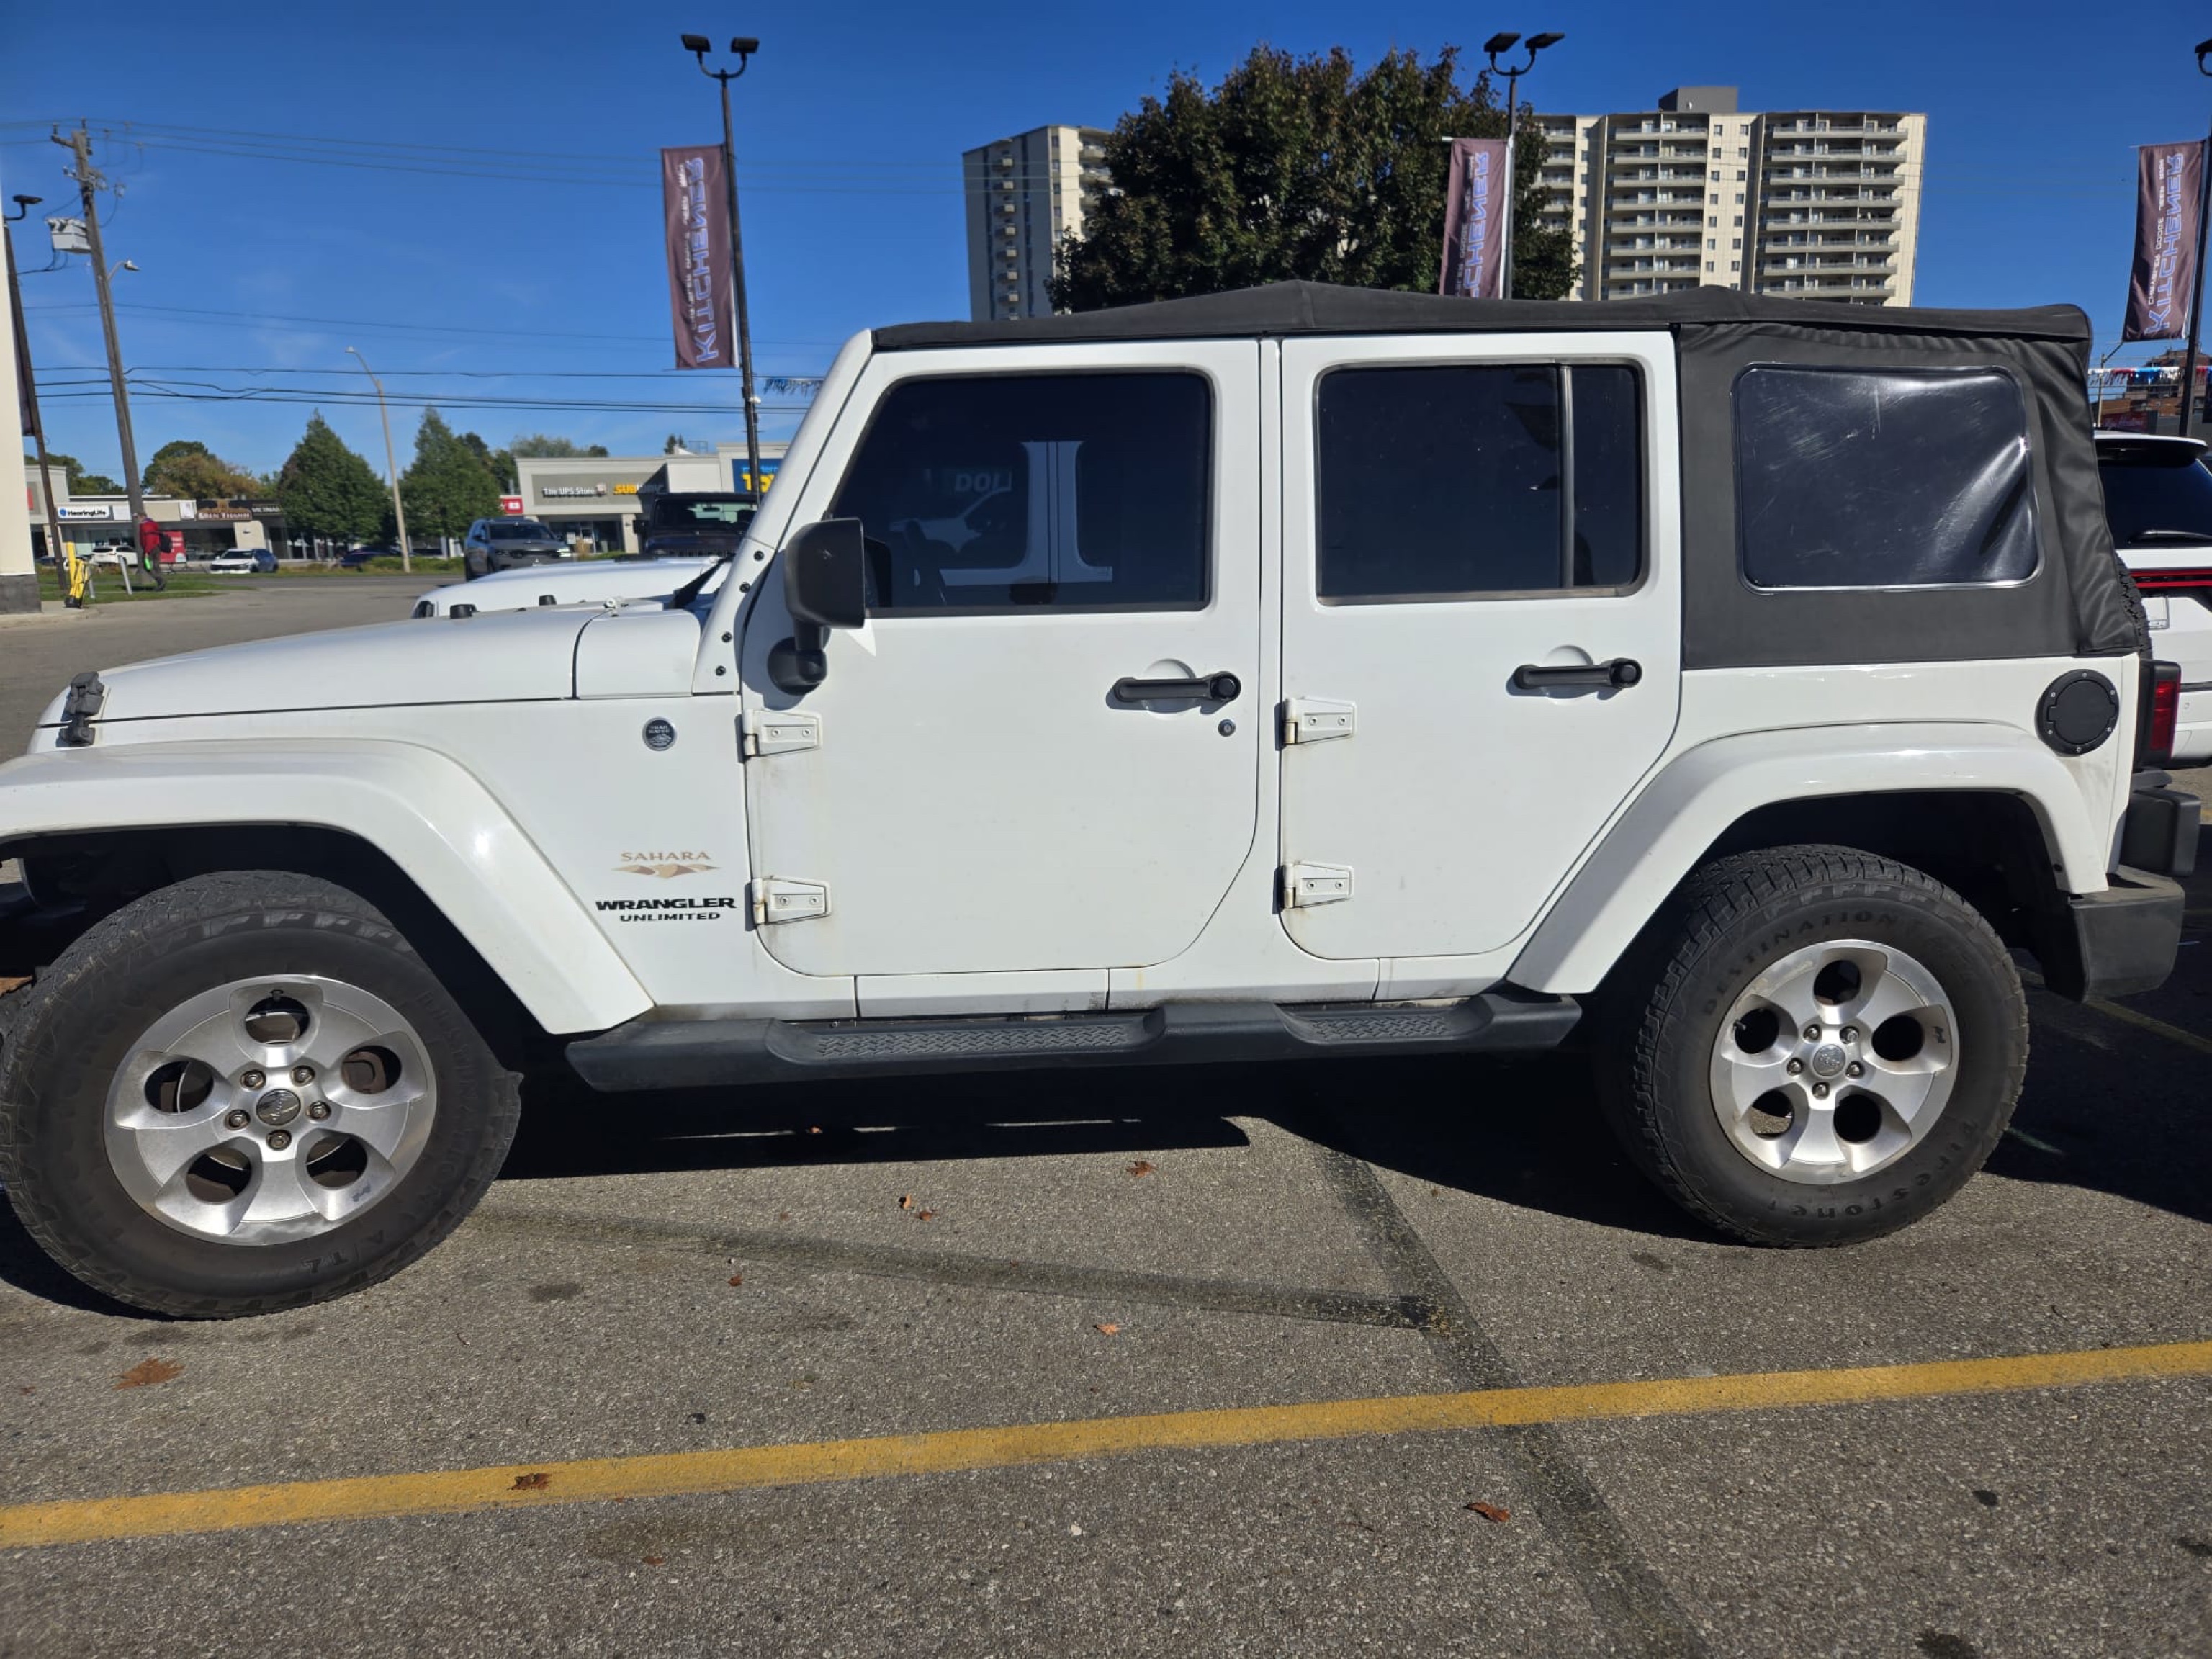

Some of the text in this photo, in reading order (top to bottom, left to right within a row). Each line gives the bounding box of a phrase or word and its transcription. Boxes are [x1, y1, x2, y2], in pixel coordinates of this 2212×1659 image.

[620, 851, 711, 862] SAHARA
[595, 897, 737, 911] WRANGLER
[620, 912, 721, 922] UNLIMITED
